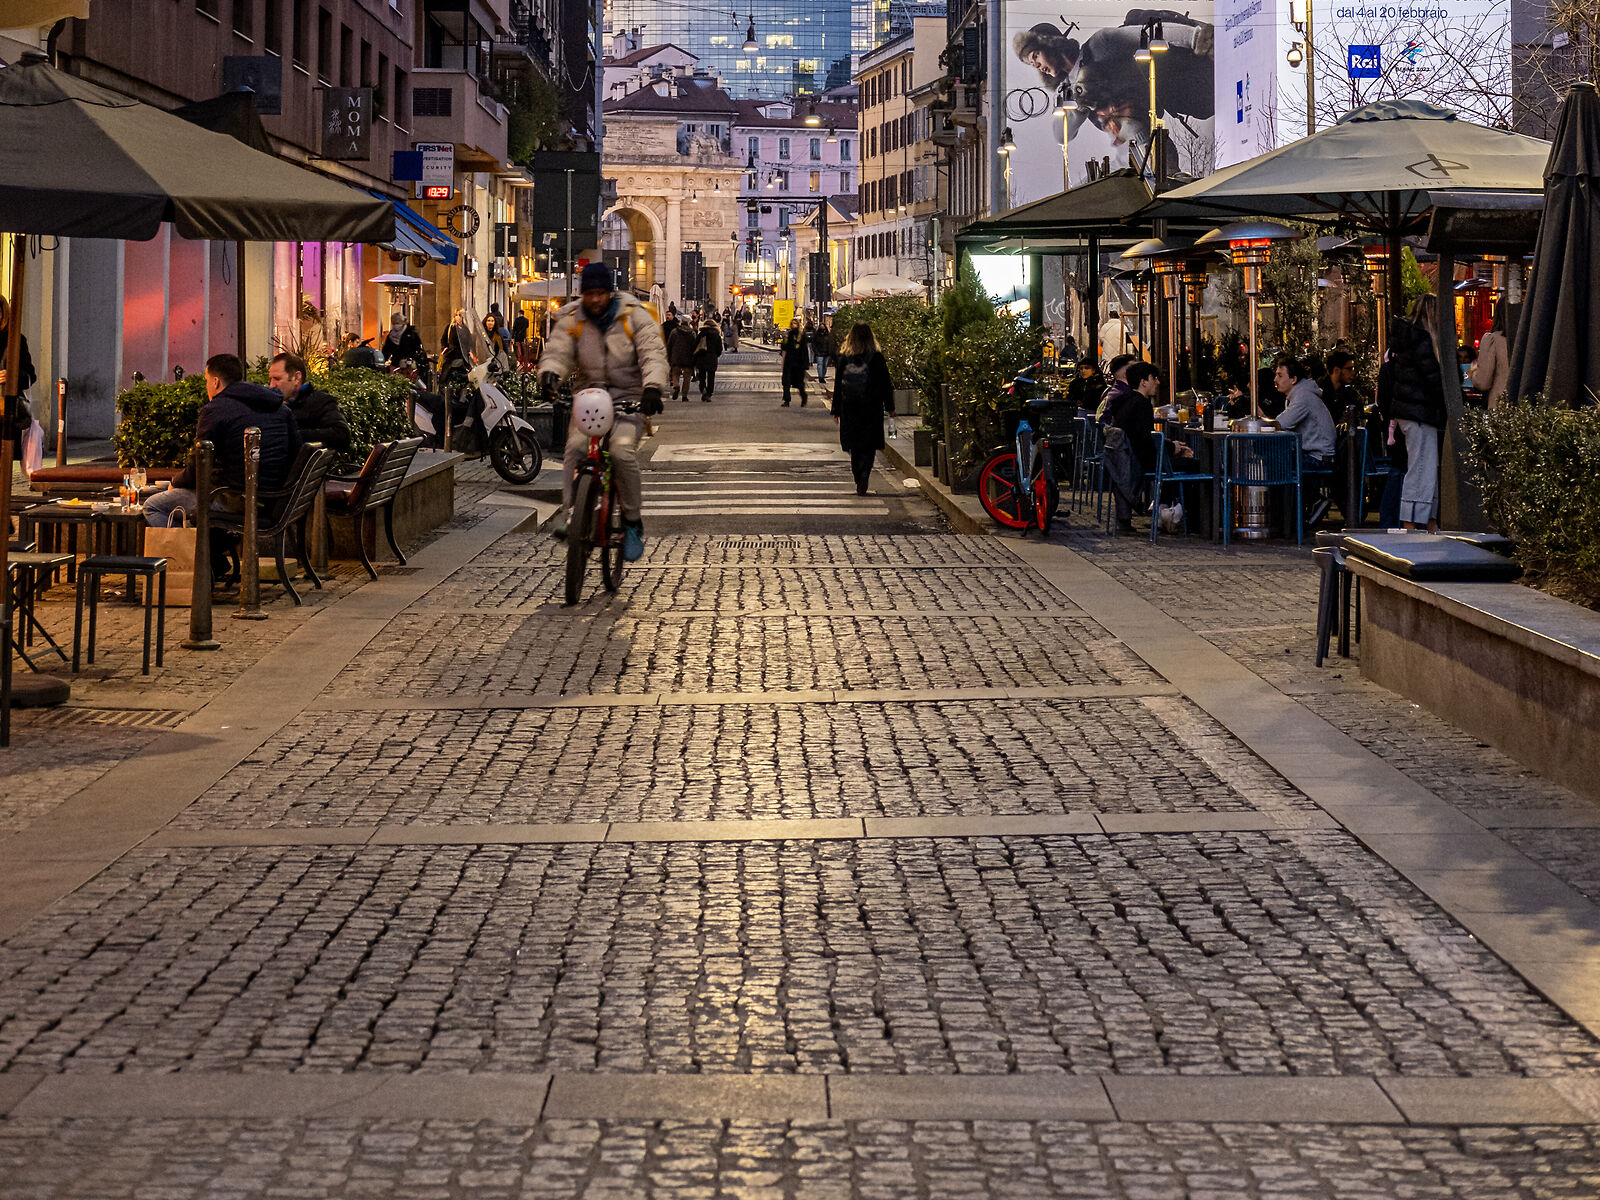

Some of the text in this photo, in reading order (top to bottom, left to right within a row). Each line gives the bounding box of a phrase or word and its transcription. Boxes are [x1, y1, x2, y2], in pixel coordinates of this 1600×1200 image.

[1336, 6, 1448, 18] dal 4 al 20 febbraio
[1351, 54, 1378, 69] Rai
[348, 96, 361, 152] MOMA
